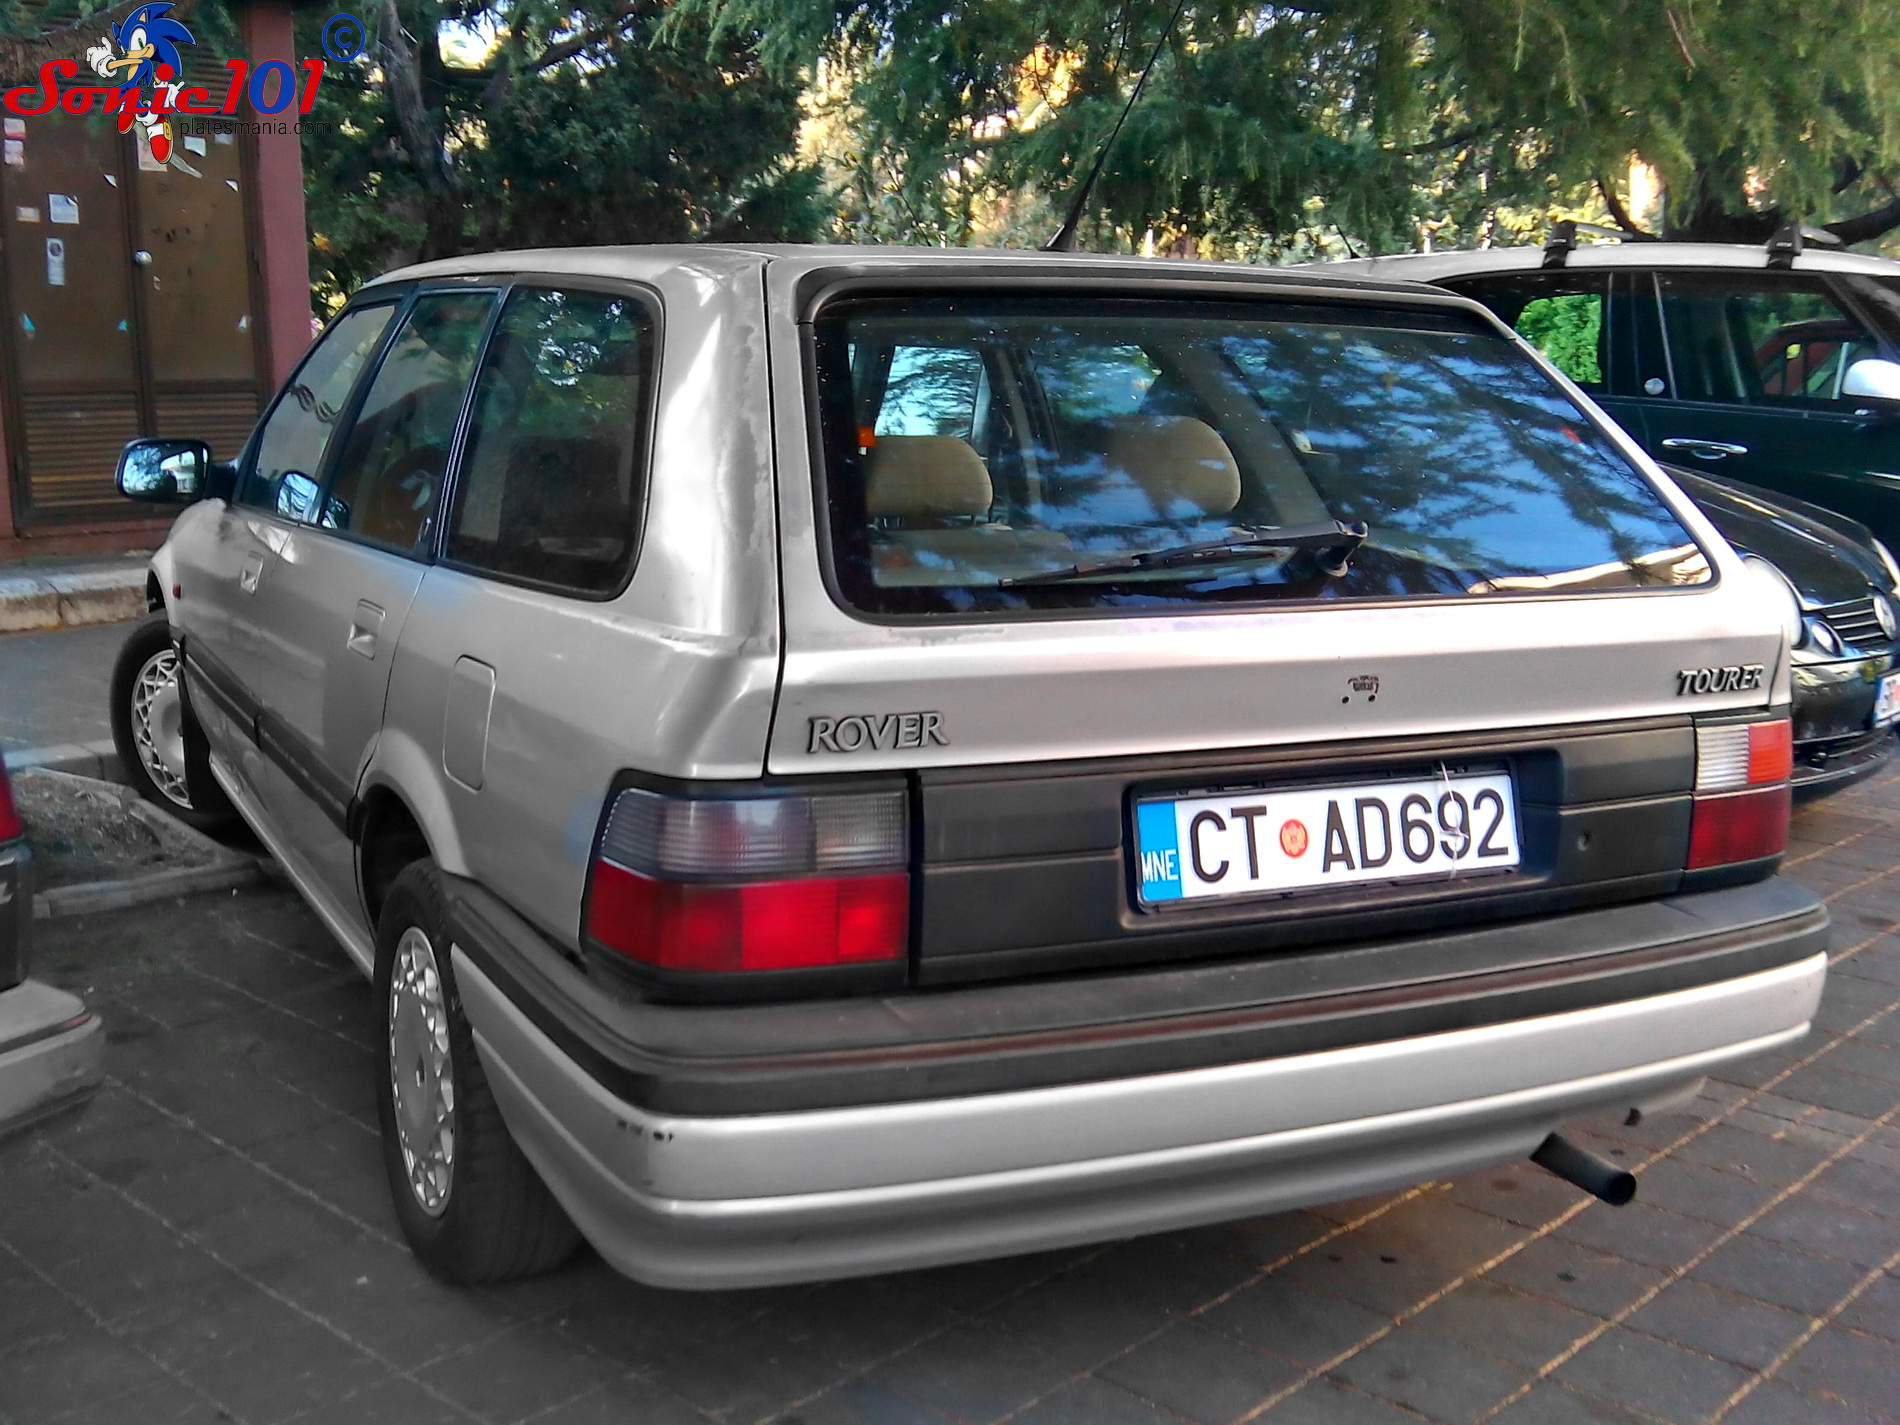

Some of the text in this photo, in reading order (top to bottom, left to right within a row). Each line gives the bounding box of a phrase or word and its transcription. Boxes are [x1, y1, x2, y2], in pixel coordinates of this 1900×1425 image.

[1677, 663, 1764, 696] TOURER
[807, 712, 949, 754] ROVER
[1189, 787, 1509, 882] CT AD692
[1142, 850, 1178, 881] MNE
